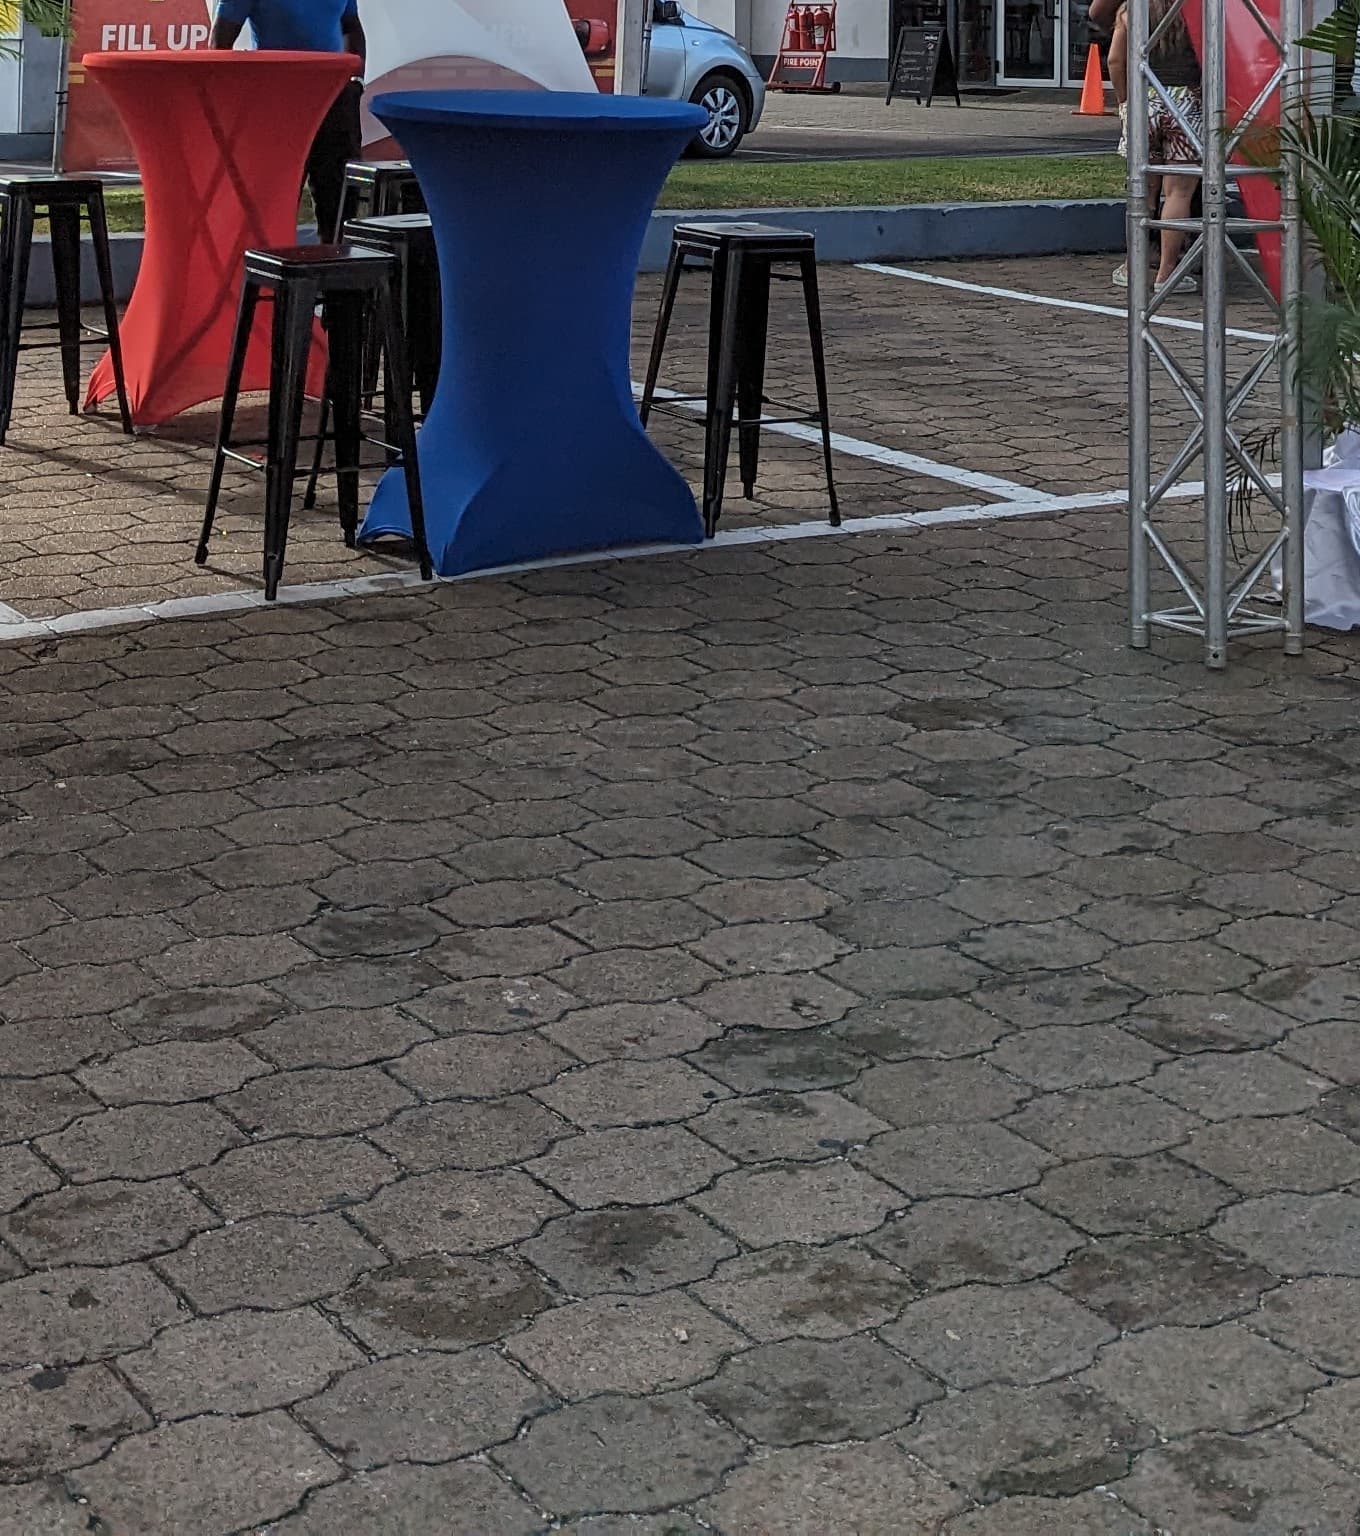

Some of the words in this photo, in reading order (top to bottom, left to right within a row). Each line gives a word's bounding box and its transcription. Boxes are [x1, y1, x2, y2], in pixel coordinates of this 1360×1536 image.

[101, 24, 157, 51] FILL
[167, 24, 208, 52] UP
[783, 57, 798, 67] FIRE
[799, 57, 822, 67] POINT
